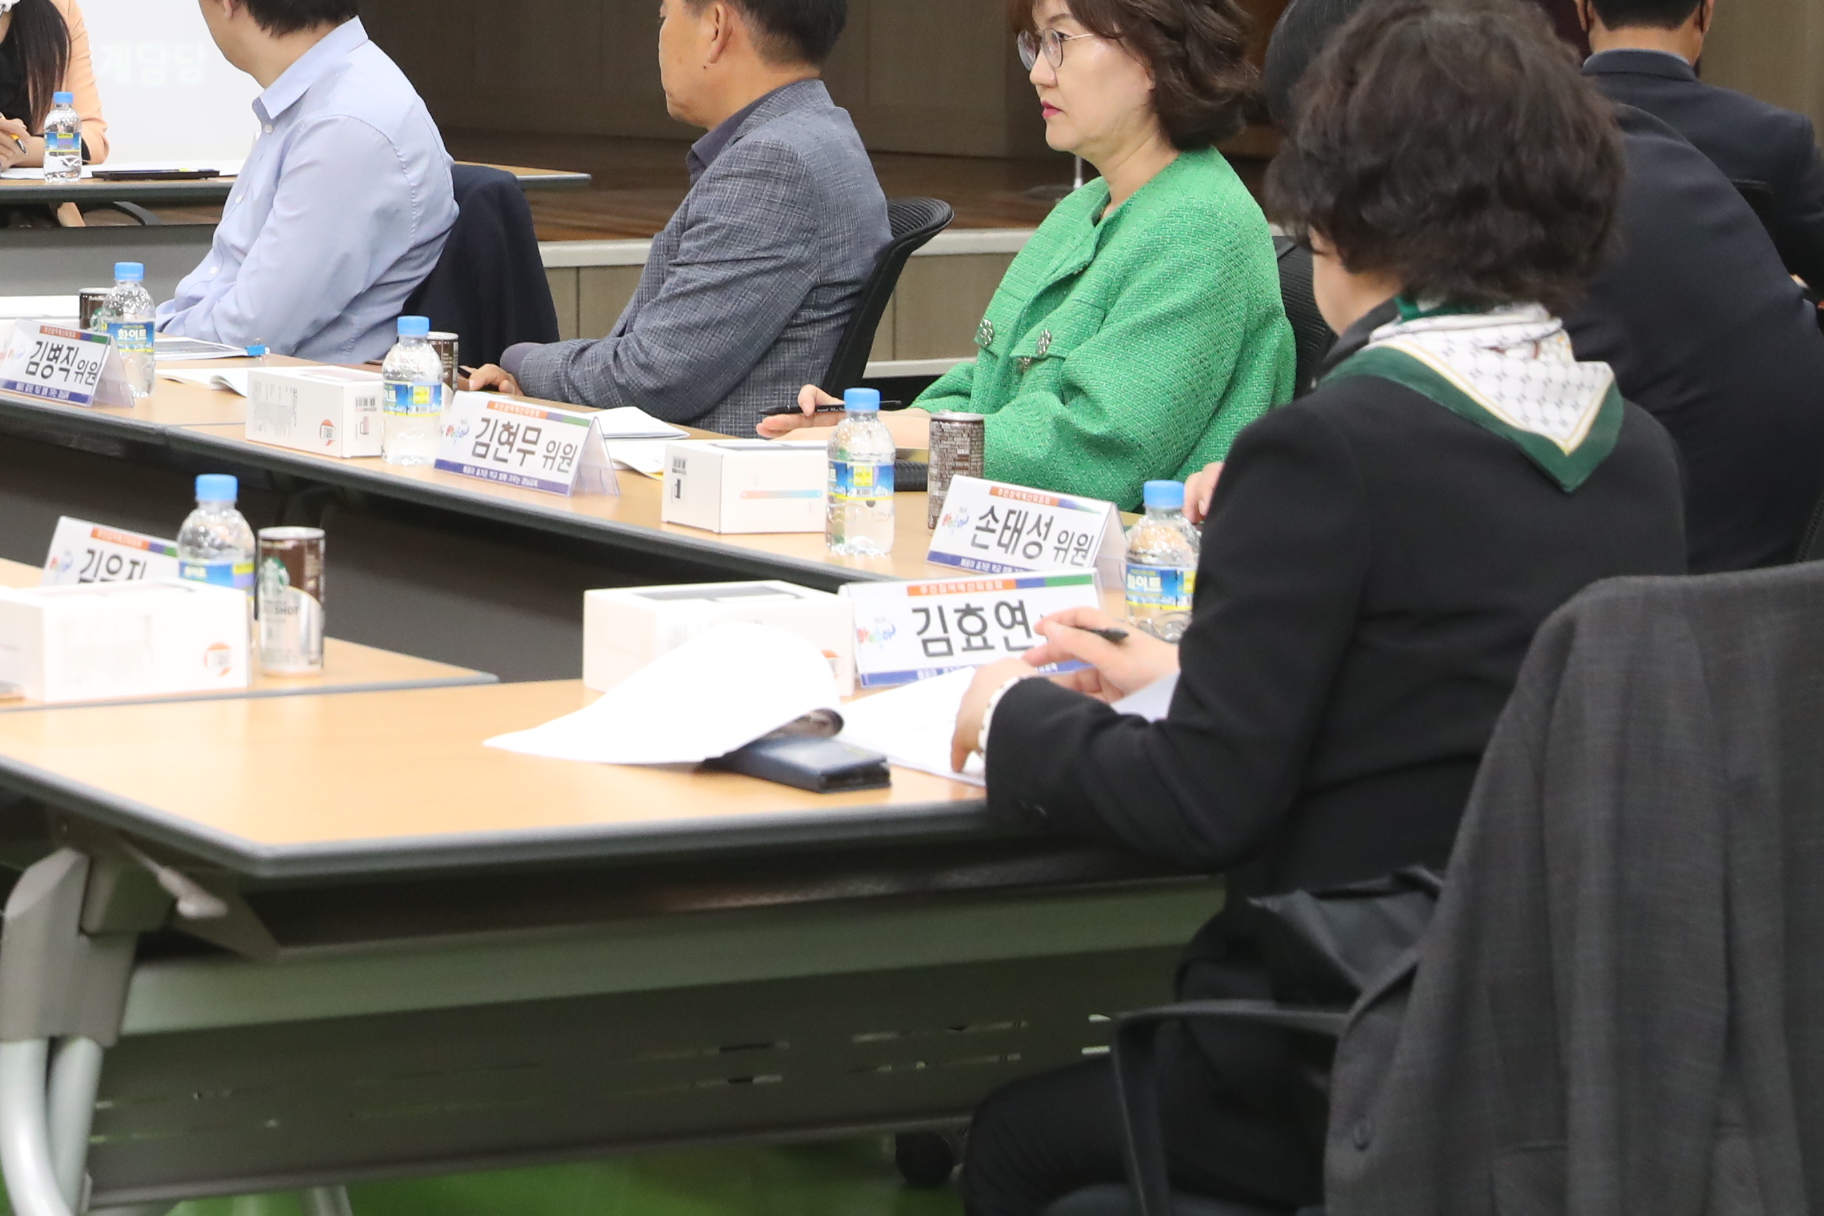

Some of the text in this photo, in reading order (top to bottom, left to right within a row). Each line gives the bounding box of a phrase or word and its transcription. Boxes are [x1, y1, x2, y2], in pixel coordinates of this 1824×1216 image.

[25, 340, 98, 385] 김병직 위원
[471, 417, 543, 467] 김현무
[543, 440, 578, 473] 위원
[971, 505, 1054, 560] 손태성
[1053, 529, 1095, 567] 위원
[911, 599, 1035, 658] 김효연
